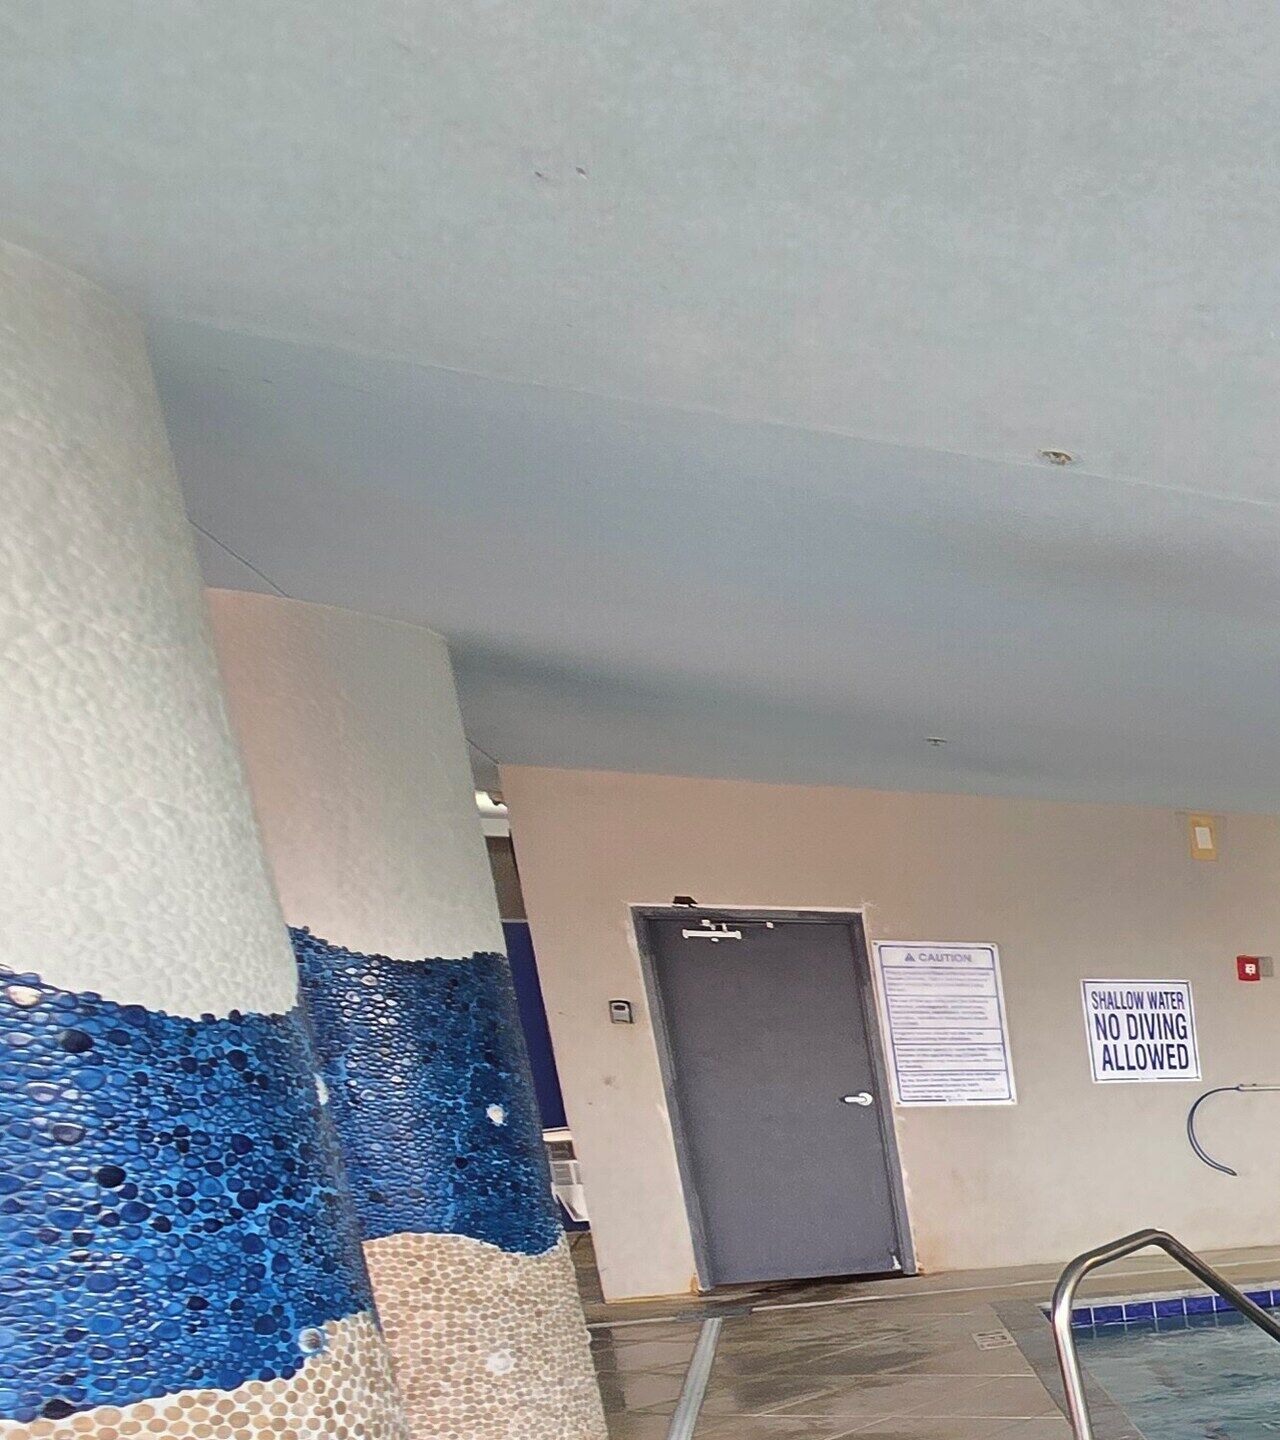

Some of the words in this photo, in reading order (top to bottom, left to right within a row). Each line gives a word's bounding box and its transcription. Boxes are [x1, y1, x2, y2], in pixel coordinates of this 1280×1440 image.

[918, 953, 973, 962] CAUTION
[1091, 991, 1144, 1010] SHALLOW
[1146, 991, 1185, 1010] WATER
[1094, 1013, 1120, 1041] NO
[1126, 1013, 1188, 1040] DIVING
[1102, 1043, 1189, 1071] ALLOWED
